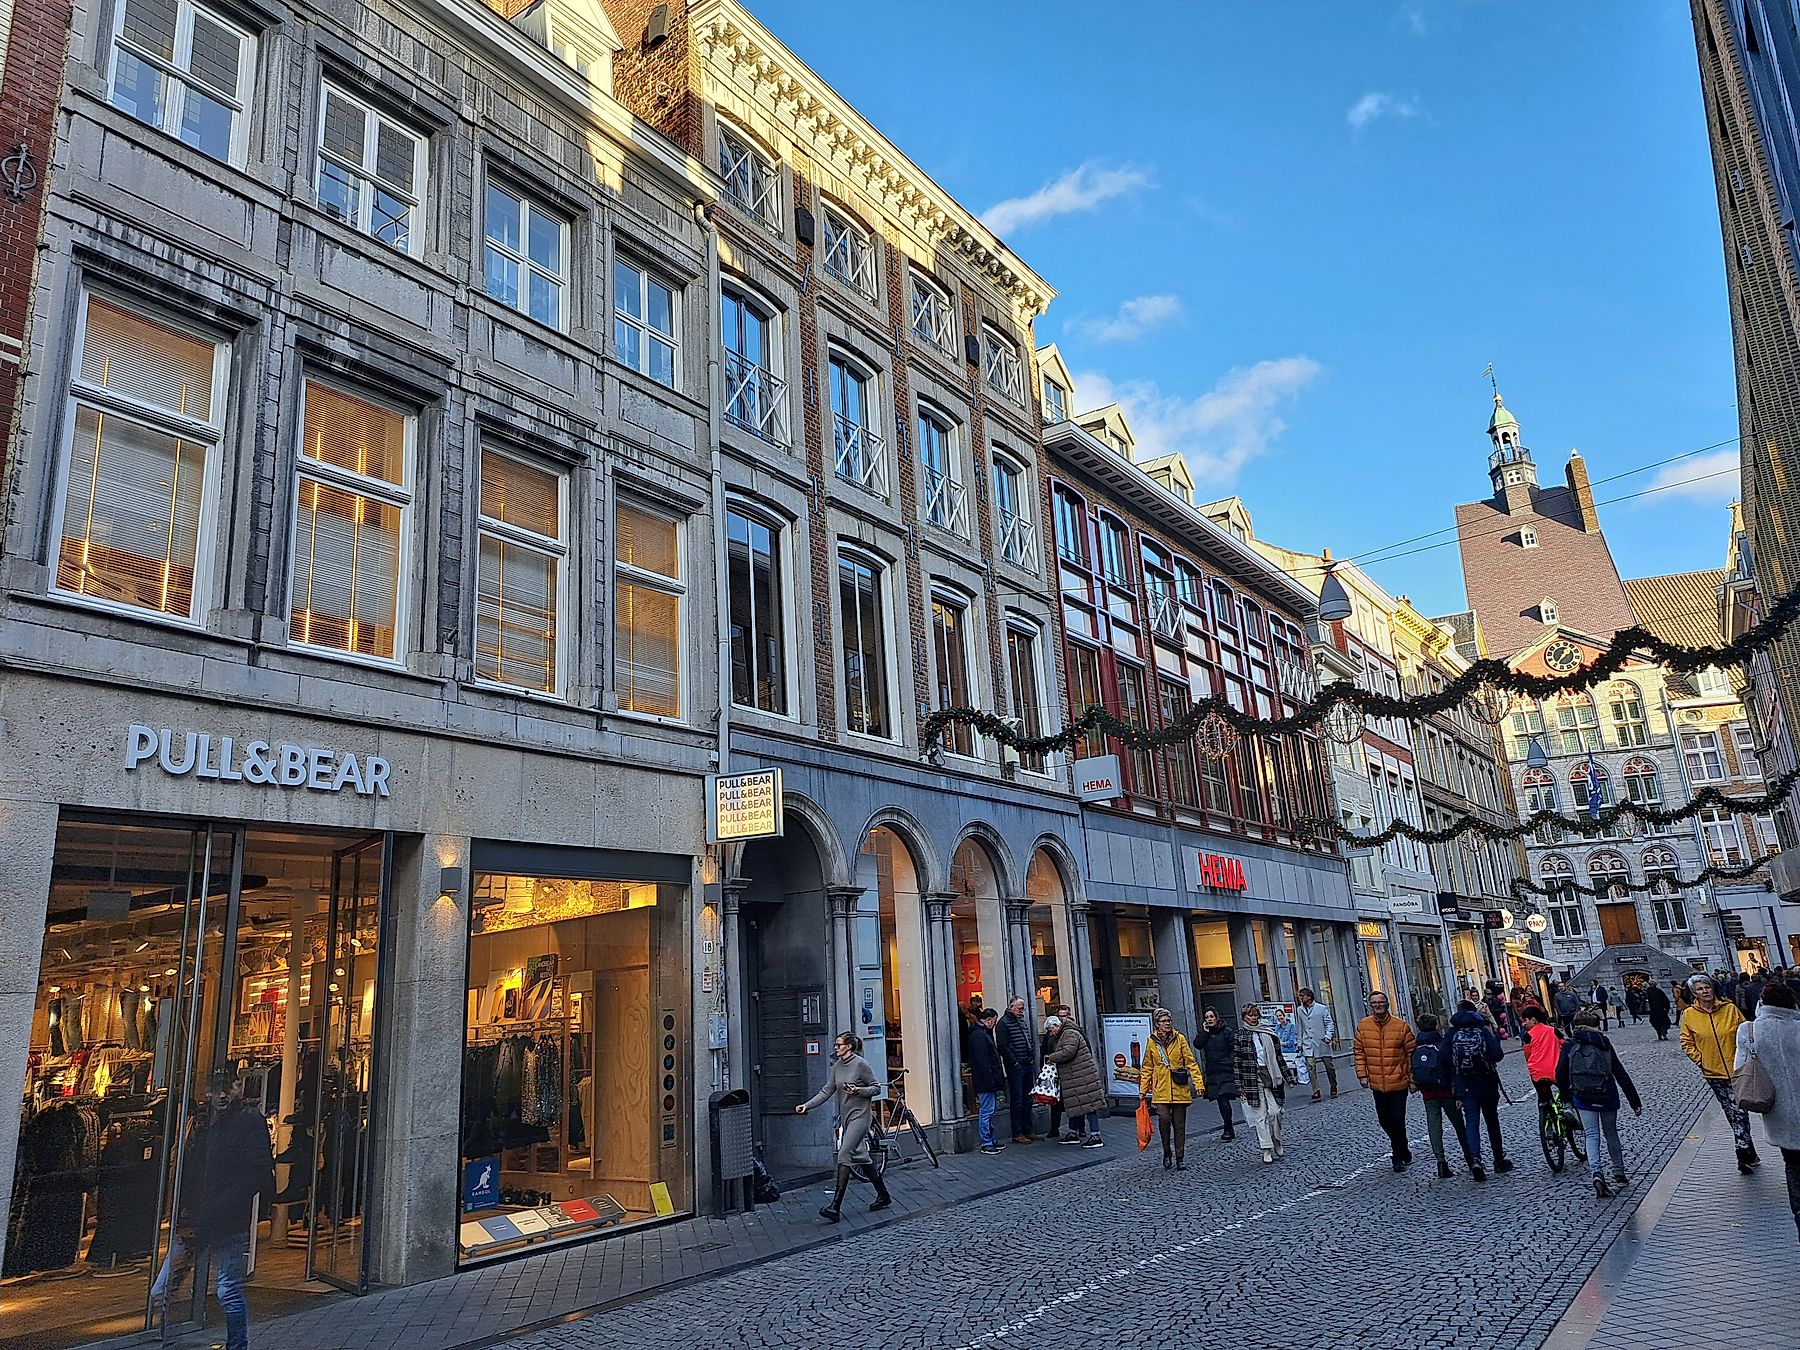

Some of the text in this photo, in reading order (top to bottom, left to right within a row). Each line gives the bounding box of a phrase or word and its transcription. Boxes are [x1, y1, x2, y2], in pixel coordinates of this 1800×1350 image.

[125, 724, 392, 797] PULL&BEAR
[719, 775, 771, 790] PULL&BEAR
[1082, 778, 1113, 792] HEMA
[719, 787, 772, 801] PULL&BEAR
[719, 798, 772, 812] PULL&BEAR
[719, 810, 772, 824] PULL&BEAR
[719, 821, 773, 836] PULL&BEAR
[1197, 852, 1248, 891] HEMA
[704, 942, 712, 952] 18
[471, 1189, 491, 1197] KANGOL
